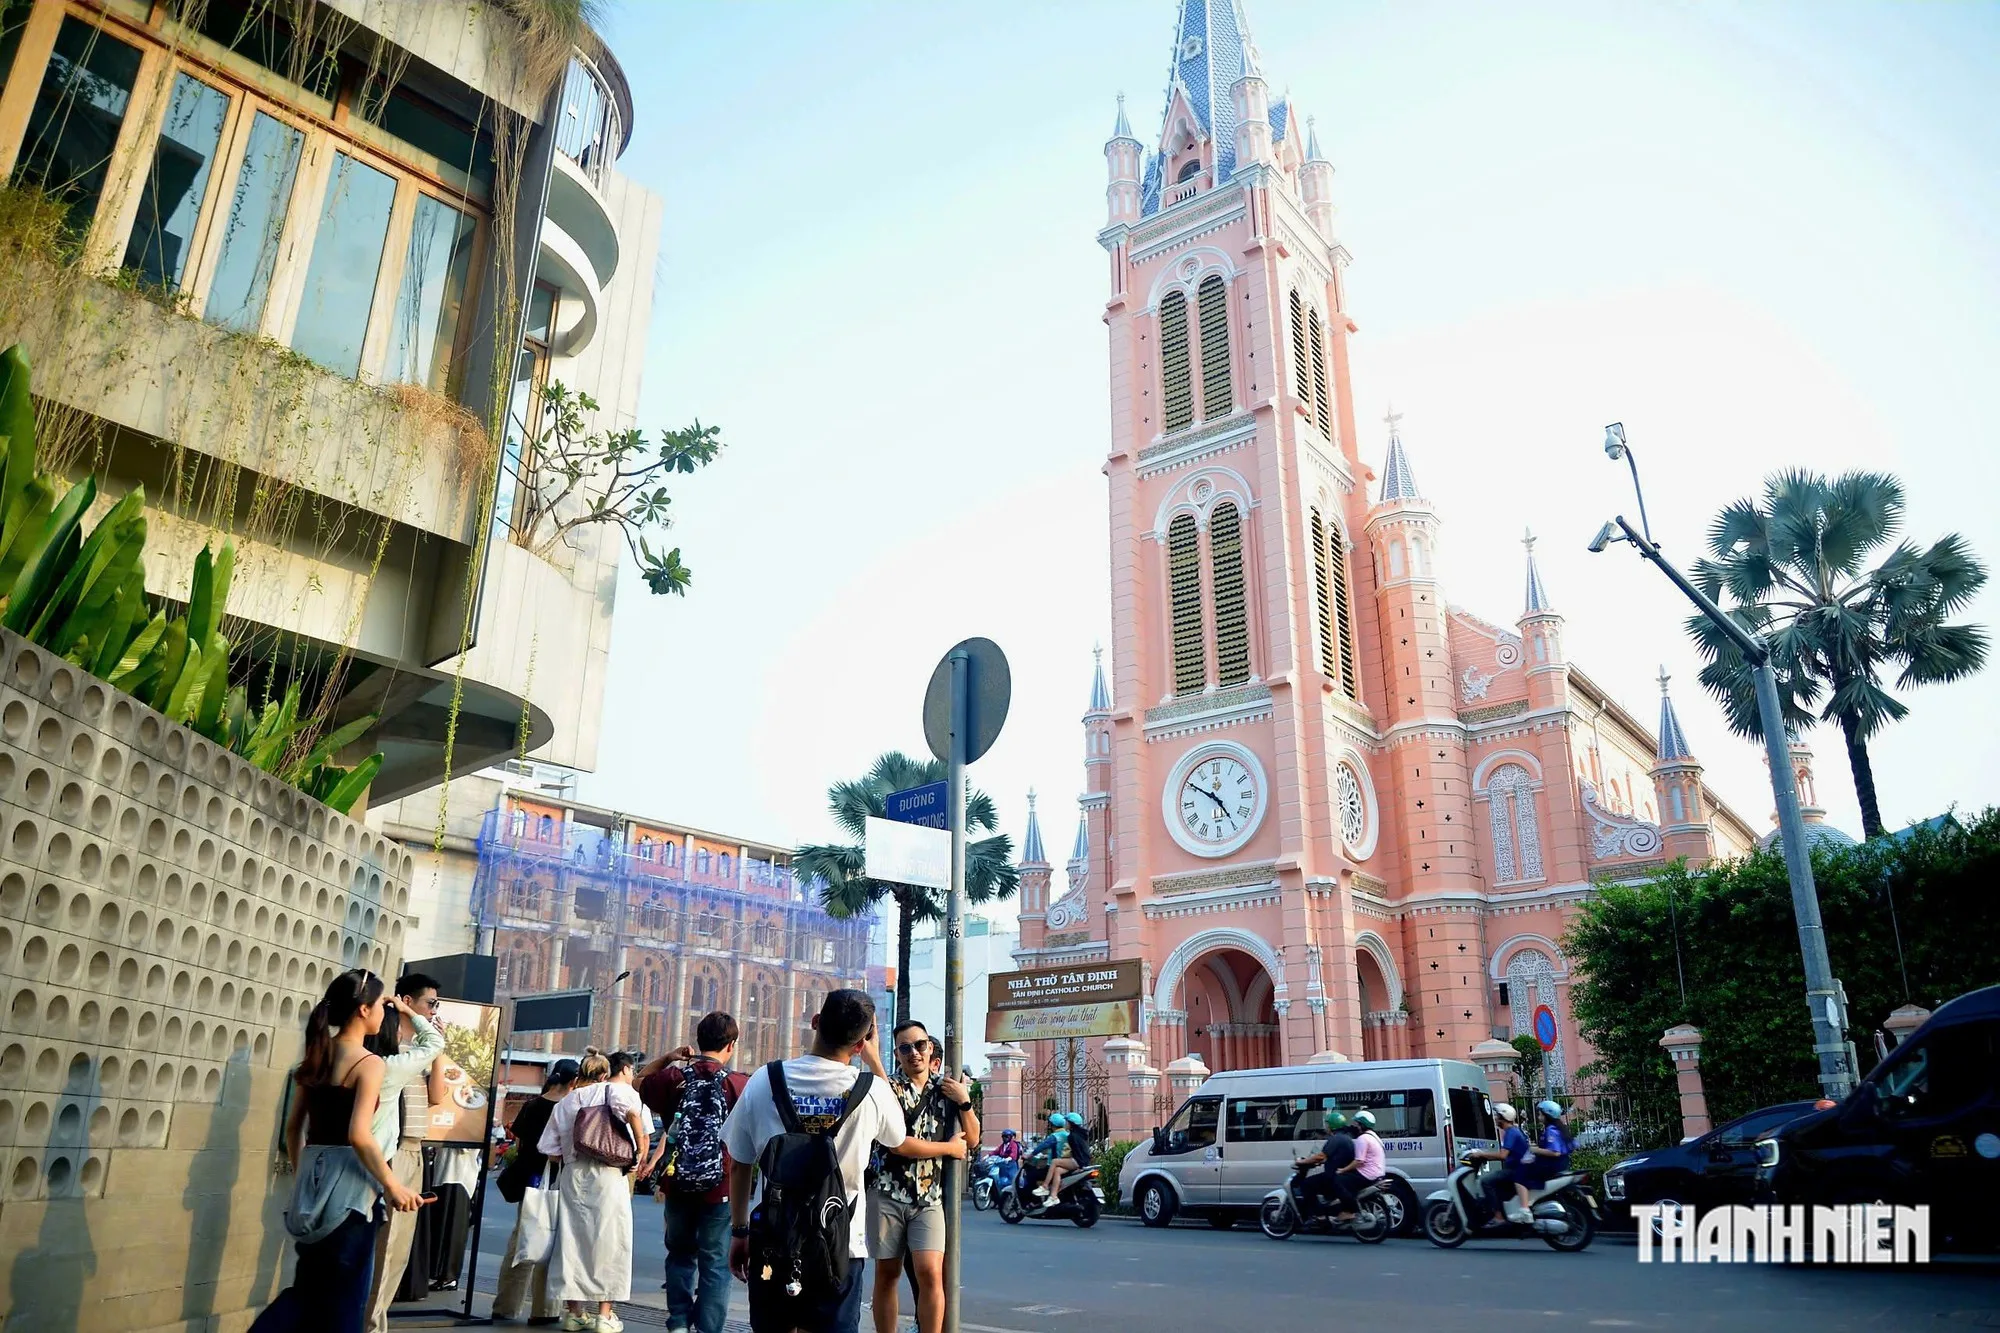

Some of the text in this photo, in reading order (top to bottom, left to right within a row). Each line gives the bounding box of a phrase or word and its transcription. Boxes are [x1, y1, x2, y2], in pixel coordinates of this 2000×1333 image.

[899, 792, 935, 812] ĐƯỜNG
[949, 929, 961, 939] 96
[1008, 970, 1118, 990] NHÀ THỜ TÂN ĐỊNH
[1012, 990, 1026, 998] TÂN
[1045, 986, 1080, 996] CATHOLIC
[1082, 983, 1114, 992] CHURCH
[794, 1095, 820, 1105] ack
[1383, 1141, 1423, 1151] 0F 02974
